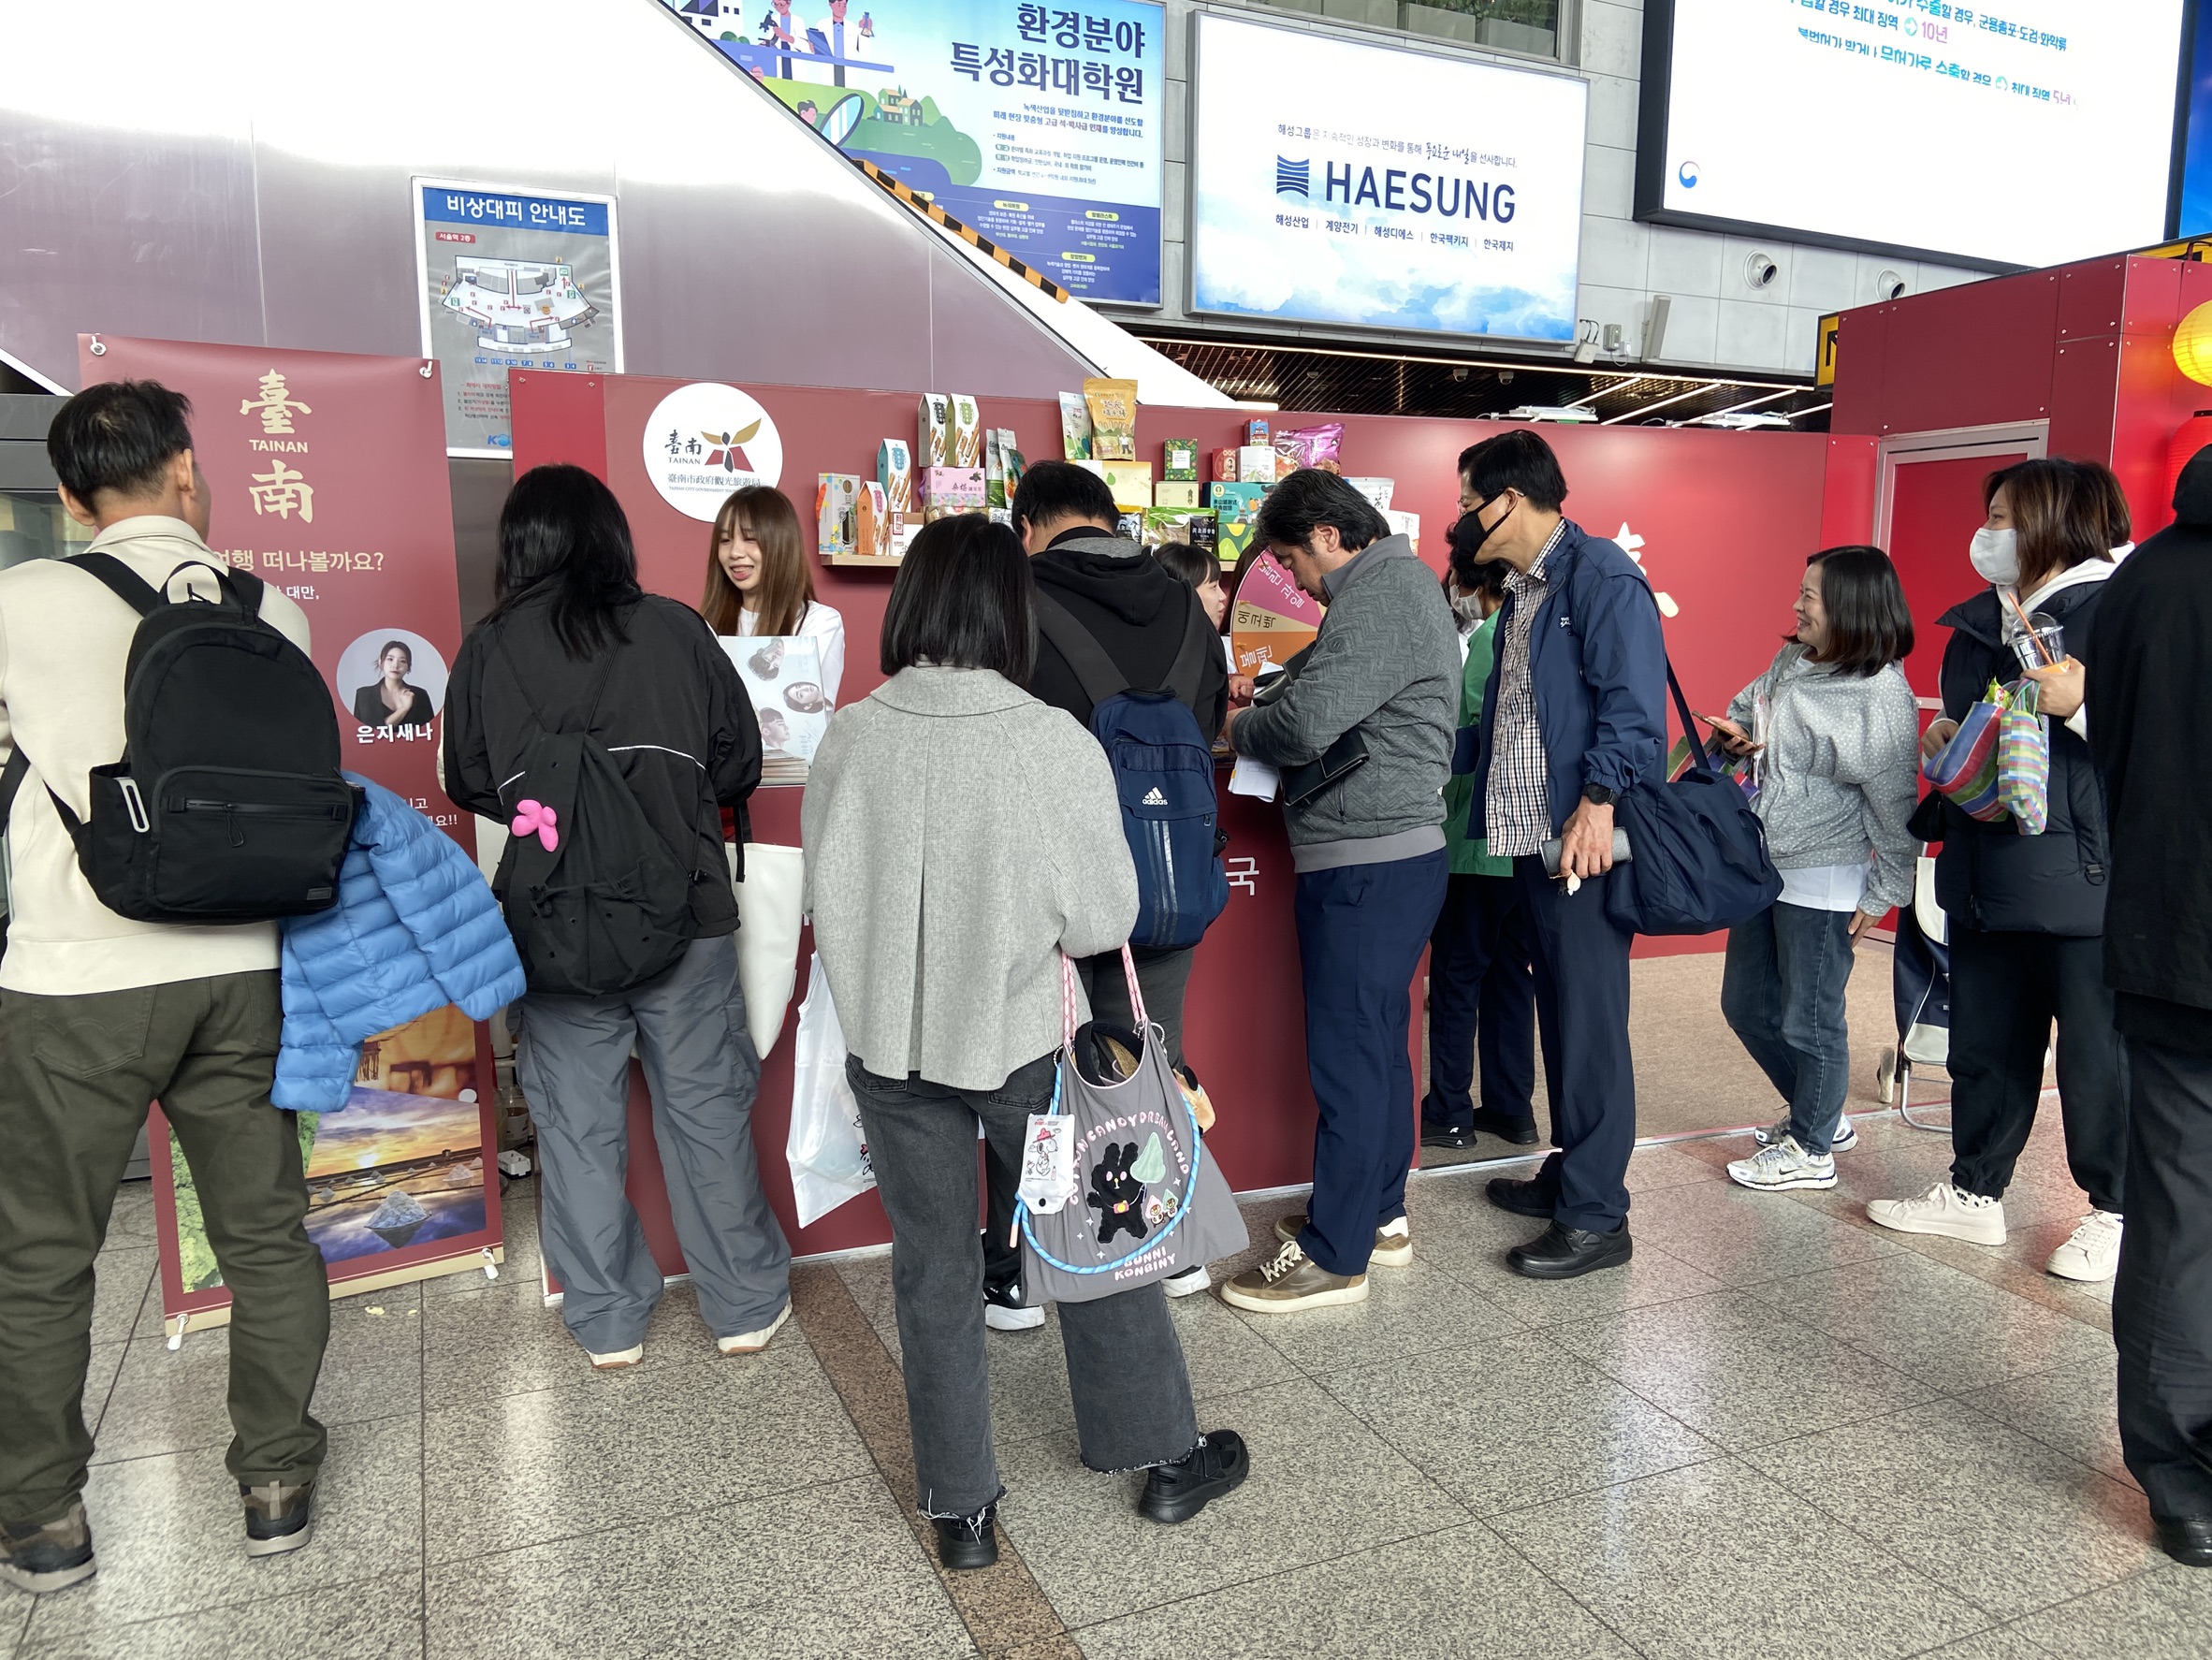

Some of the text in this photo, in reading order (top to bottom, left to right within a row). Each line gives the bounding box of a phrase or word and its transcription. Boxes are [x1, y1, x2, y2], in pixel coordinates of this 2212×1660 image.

[1017, 3, 1145, 58] 환경분야
[1853, 5, 1875, 24] 최대
[1877, 11, 1899, 31] 징역
[1921, 21, 1948, 44] 10년
[950, 42, 1142, 105] 특성화대학원
[993, 110, 1007, 121] 미래
[1008, 112, 1022, 123] 현장
[1024, 114, 1043, 125] 맞춤형
[1044, 118, 1058, 127] 고급
[1088, 123, 1109, 135] 인재를
[1091, 111, 1123, 124] 환경분야를
[1124, 115, 1143, 127] 선도할
[1278, 124, 1320, 140] 해성그룹은
[1357, 136, 1380, 149] 성장과
[1382, 139, 1404, 153] 변화를
[1406, 142, 1422, 155] 통해
[1452, 148, 1477, 165] 내일을
[1479, 153, 1518, 168] 선사합니다.
[1325, 160, 1516, 224] HAESUNG
[446, 195, 586, 226] 비상대피 안내도
[1275, 213, 1514, 252] 해성산업 계양전기 해성디에스 한국팩키지 한국제지
[240, 368, 313, 434] 臺
[249, 439, 309, 454] TAINAN
[664, 429, 702, 456] 臺南
[668, 456, 701, 465] TAINAN
[248, 459, 314, 524] 南
[262, 549, 385, 573] 떠나볼까요?
[286, 585, 320, 600] 대만,
[1280, 583, 1305, 608] 과일
[1238, 610, 1276, 629] 에코백
[1240, 645, 1273, 667] 볼펜
[357, 721, 434, 744] 은지새나
[1114, 1252, 1176, 1281] KONBINY
